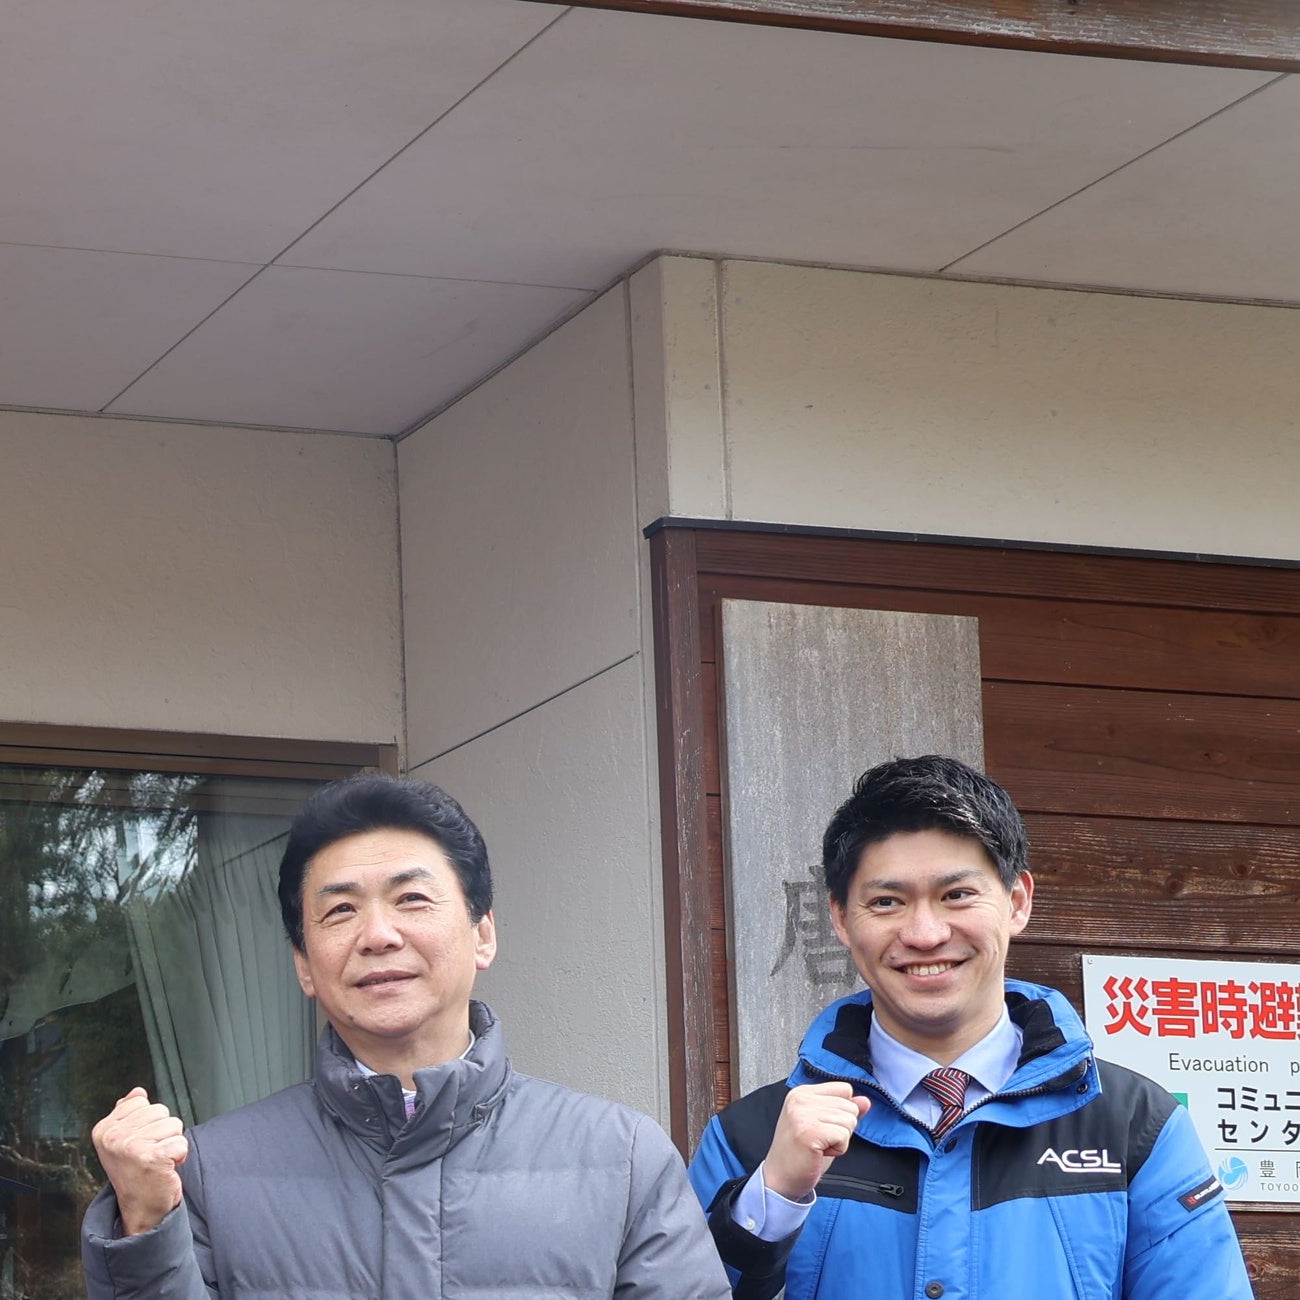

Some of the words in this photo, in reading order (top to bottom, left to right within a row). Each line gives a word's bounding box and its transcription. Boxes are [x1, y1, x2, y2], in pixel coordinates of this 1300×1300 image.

[1102, 975, 1300, 1041] 災害時避
[1169, 1052, 1269, 1073] Evacuation
[1036, 1147, 1122, 1174] ACSL
[1260, 1159, 1300, 1178] 豊
